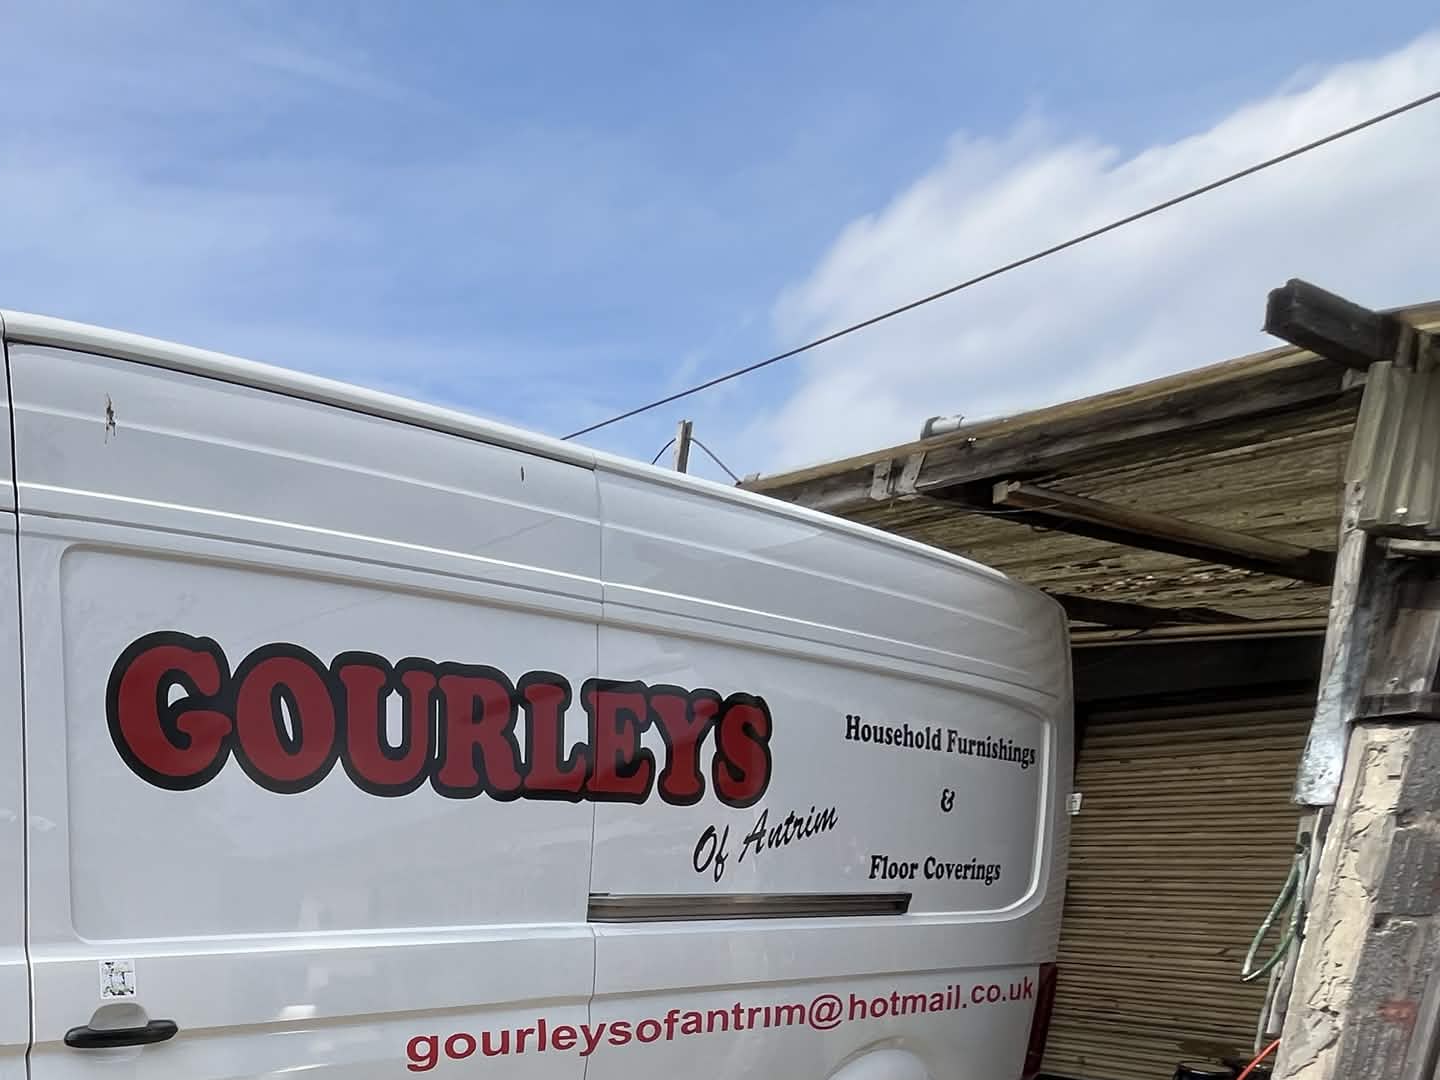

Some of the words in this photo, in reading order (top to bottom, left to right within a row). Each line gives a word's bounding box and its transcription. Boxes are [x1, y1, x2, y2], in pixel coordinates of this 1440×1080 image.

[106, 630, 772, 808] GOURLEYS
[845, 714, 942, 752] Household
[947, 729, 1036, 769] Furnishings
[940, 788, 955, 812] &
[693, 824, 729, 882] Of
[738, 806, 838, 862] Antrim
[868, 854, 918, 880] Floor
[924, 855, 1001, 886] Coverings
[406, 975, 1034, 1072] gourleysofantrim@hotmail.co.uk
